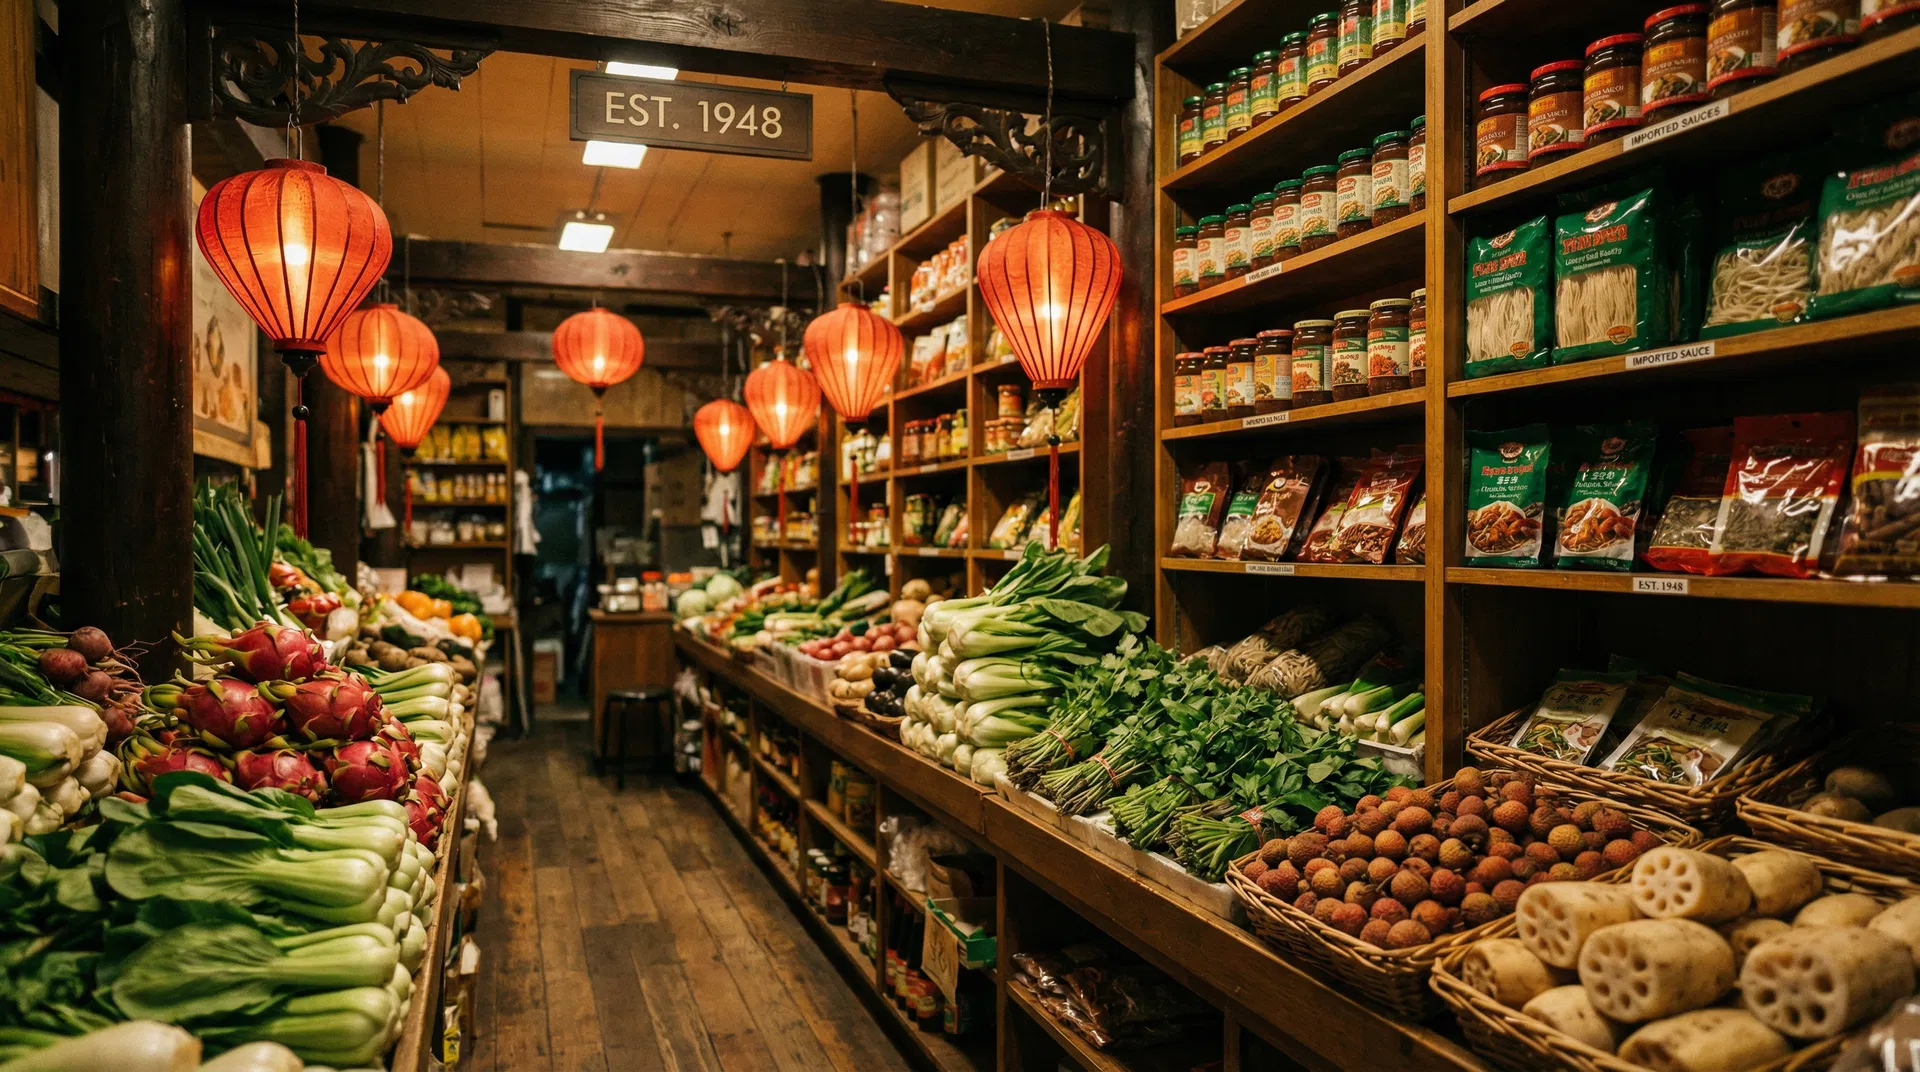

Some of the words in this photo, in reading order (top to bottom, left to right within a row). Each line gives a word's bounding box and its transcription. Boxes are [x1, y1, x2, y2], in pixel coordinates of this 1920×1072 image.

[606, 91, 680, 130] EST.
[697, 101, 783, 139] 1948
[1631, 121, 1679, 146] IMPORTED
[1681, 106, 1720, 128] SAUCES
[1632, 351, 1678, 366] IMPORTED
[1680, 346, 1710, 359] SAUCE
[1638, 580, 1659, 590] EST.
[1662, 581, 1683, 591] 1948
